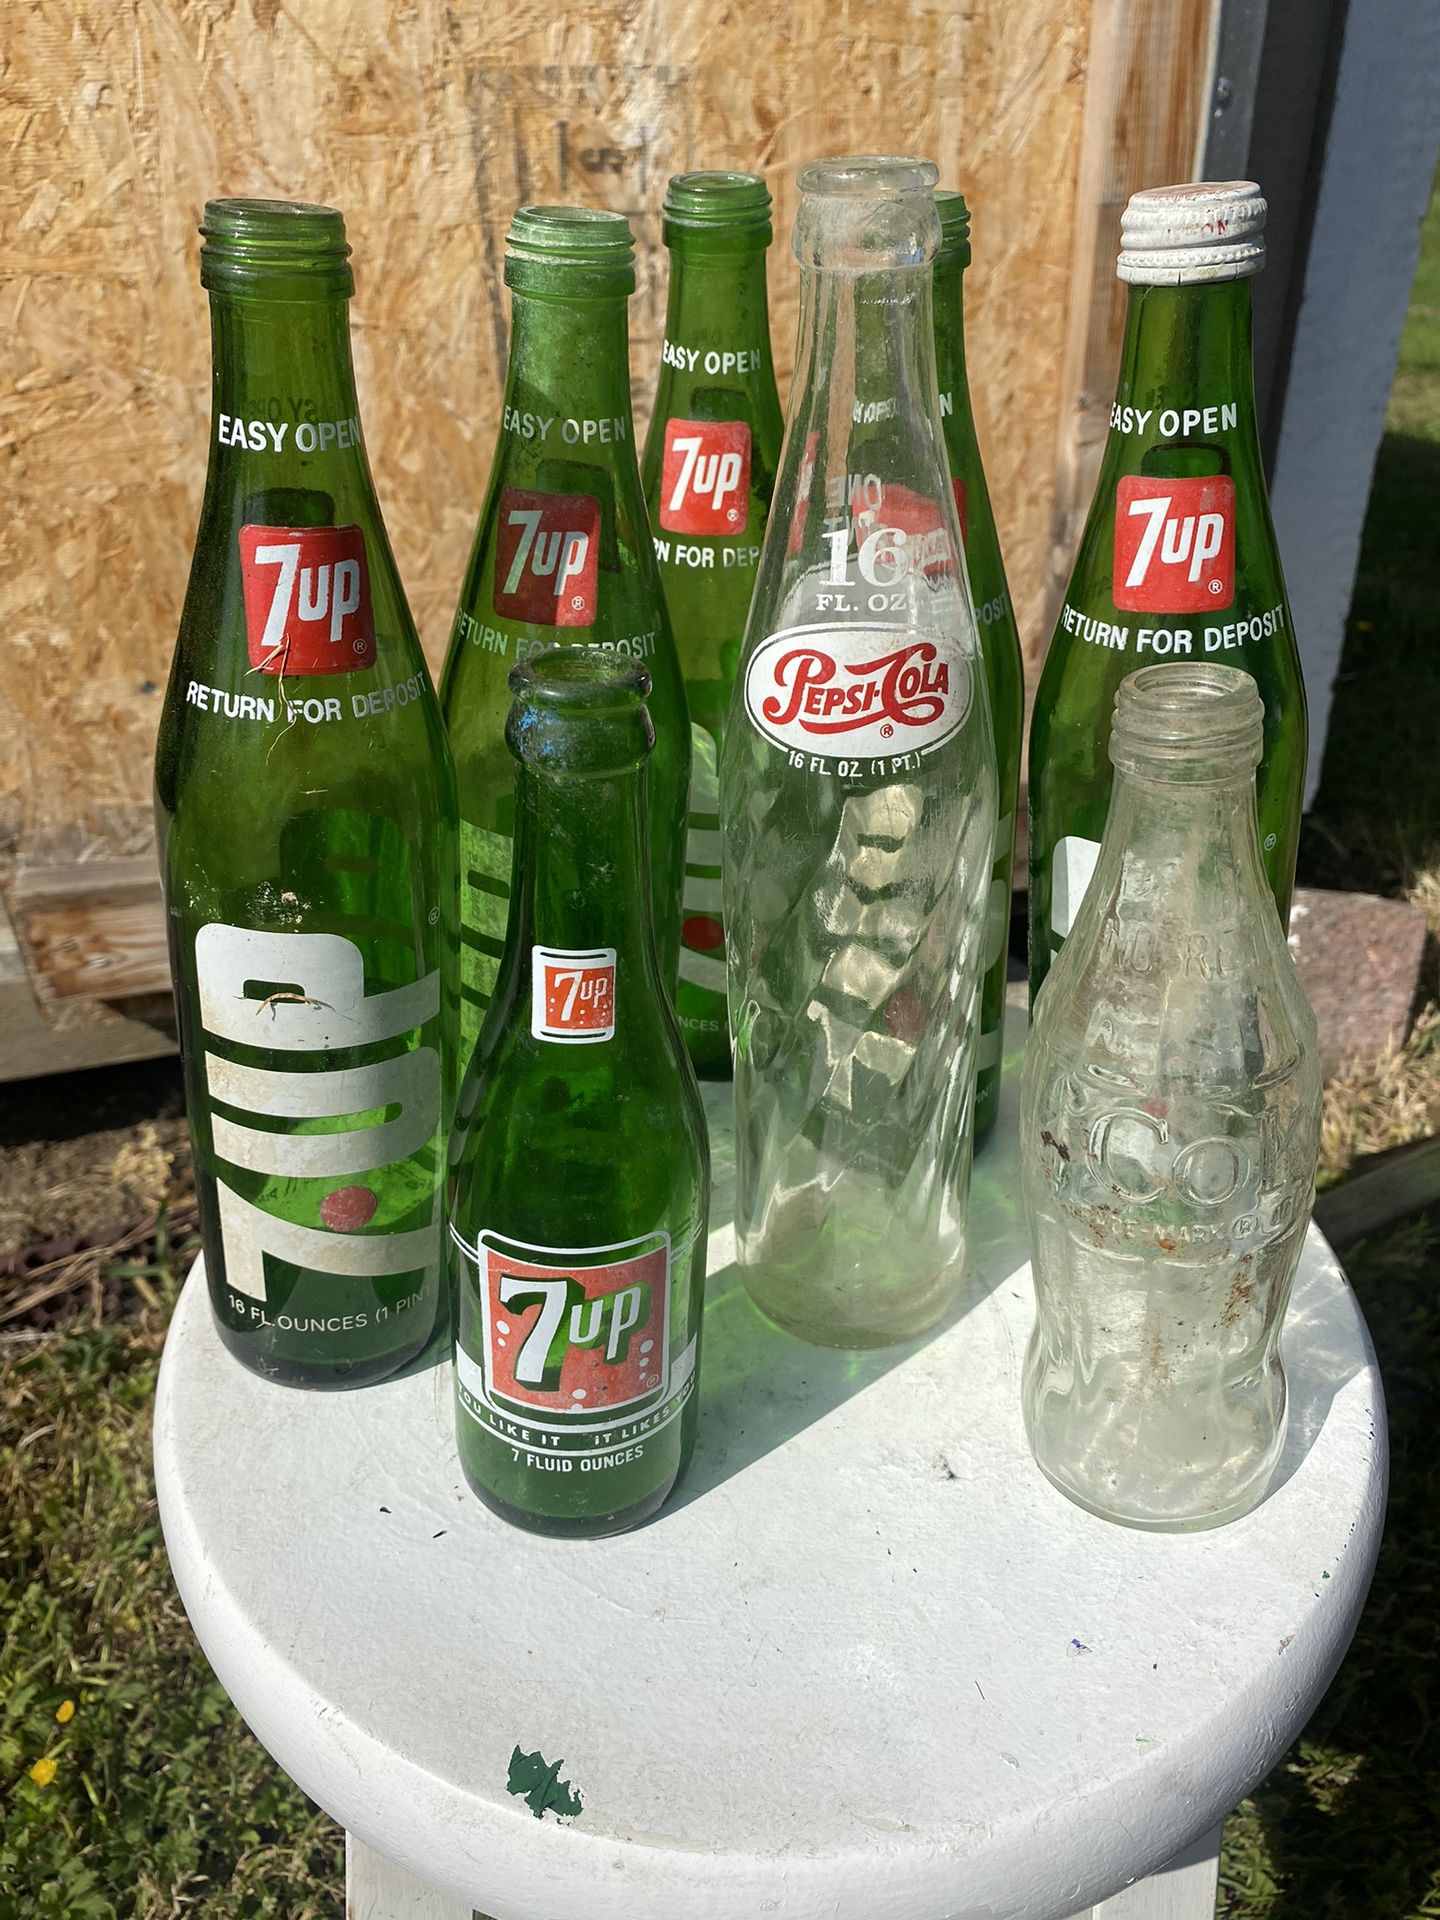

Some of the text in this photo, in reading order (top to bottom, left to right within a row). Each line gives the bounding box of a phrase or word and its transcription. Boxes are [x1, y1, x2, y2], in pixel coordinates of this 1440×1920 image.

[663, 339, 761, 375] EASY OPEN
[218, 413, 361, 453] EASY OPEN
[503, 405, 626, 444] EASY OPEN
[1110, 402, 1238, 437] EASY OPEN
[675, 544, 714, 568] FOR
[820, 528, 910, 587] 16
[816, 593, 859, 612] FL.
[457, 607, 508, 656] RETURN
[515, 637, 562, 659] FO
[1061, 604, 1286, 654] RETURN FOR DEPOSIT
[186, 671, 428, 724] RETURN FOR DEPOSIT
[788, 751, 804, 769] 16
[229, 1294, 246, 1314] 16
[277, 1312, 368, 1333] OUNCES
[489, 1413, 531, 1441] LIKE
[541, 1434, 561, 1447] IT
[594, 1432, 613, 1446] IT
[621, 1406, 670, 1440] LIKES
[511, 1445, 645, 1473] 7 FLUID OUNCES
